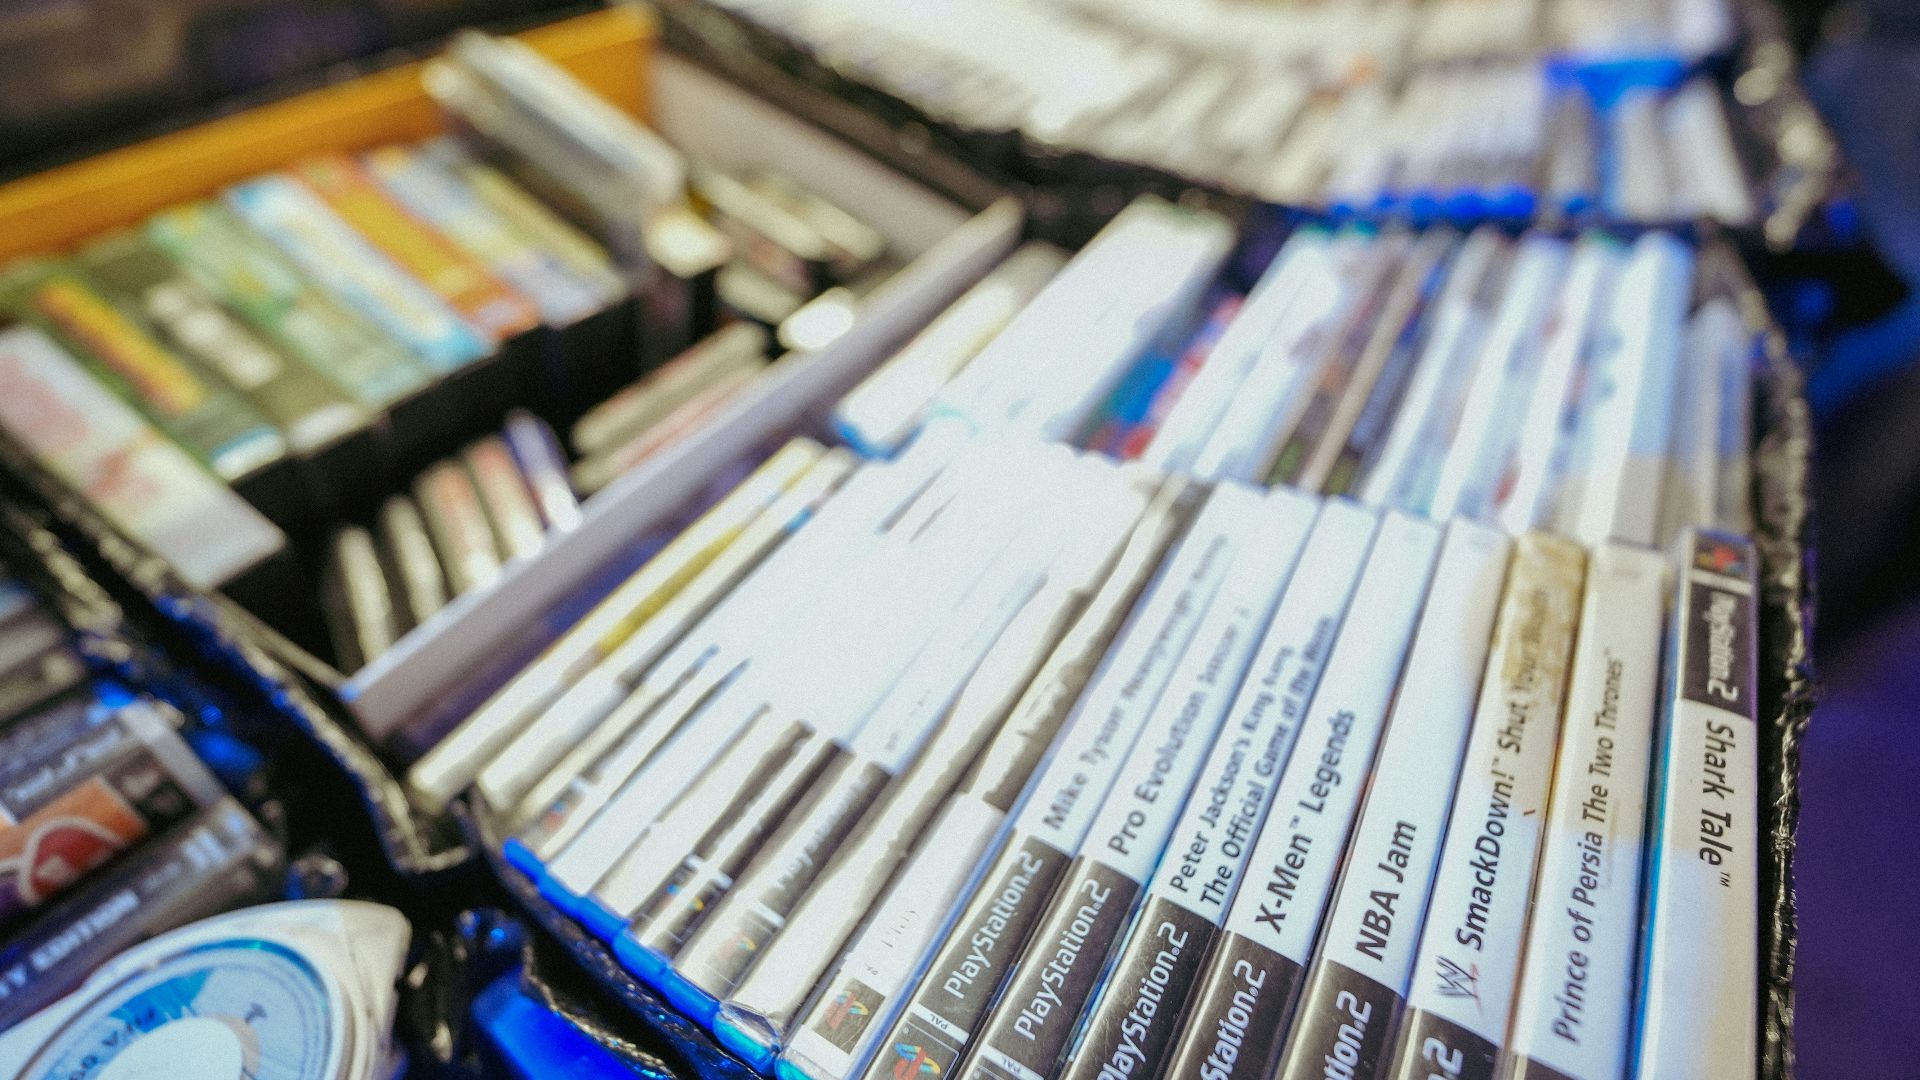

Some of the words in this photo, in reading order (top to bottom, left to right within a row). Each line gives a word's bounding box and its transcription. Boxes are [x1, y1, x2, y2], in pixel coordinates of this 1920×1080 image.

[1497, 702, 1529, 754] Shut
[1587, 732, 1613, 777] Two
[1702, 721, 1736, 801] Shark
[1107, 809, 1146, 856] Pro
[1134, 691, 1206, 805] Evolution
[1169, 830, 1210, 893] Peter
[1199, 738, 1250, 829] Jackson's
[1240, 691, 1274, 735] King
[1298, 709, 1356, 815] Legends
[1043, 772, 1088, 831] Mike
[1201, 864, 1233, 907] The
[1220, 780, 1267, 859] Official
[1254, 722, 1290, 777] Game
[1582, 783, 1609, 824] The
[1377, 820, 1417, 883] Jam
[1572, 829, 1603, 907] Persia
[1355, 889, 1400, 961] NBA
[1567, 909, 1595, 944] of
[928, 1013, 949, 1031] PAL
[1552, 952, 1590, 1045] Prince
[1001, 1056, 1022, 1074] PAL
